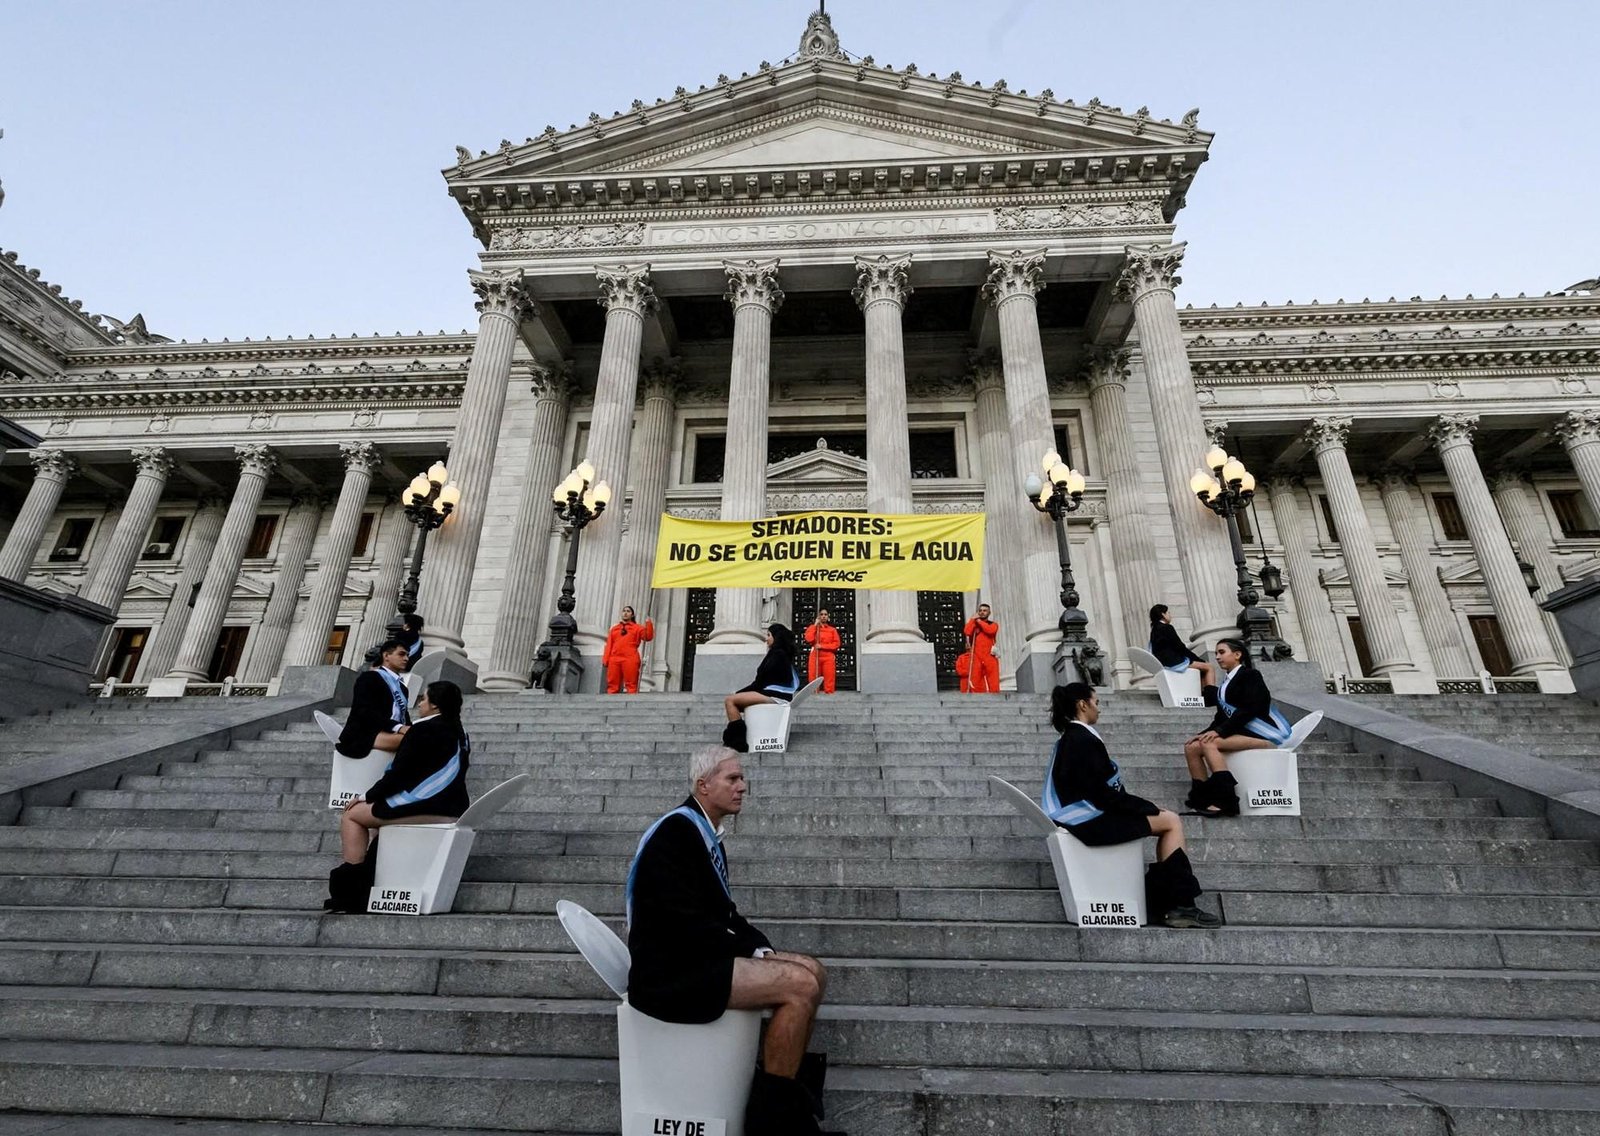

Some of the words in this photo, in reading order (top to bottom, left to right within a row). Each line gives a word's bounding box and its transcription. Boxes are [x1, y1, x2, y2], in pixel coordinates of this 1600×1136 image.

[671, 224, 817, 243] CONGRESO
[836, 218, 967, 236] NACIONAL
[751, 516, 893, 538] SENADORES:
[669, 543, 701, 561] NO
[708, 544, 736, 561] SE
[743, 540, 834, 561] CAGUEN
[841, 541, 871, 560] EN
[879, 542, 906, 561] EL
[911, 541, 974, 561] AGUA
[770, 569, 868, 583] GREENPEACE
[340, 791, 353, 800] LEY
[1257, 789, 1271, 797] LEY
[1273, 789, 1283, 797] DE
[1251, 798, 1293, 806] GLACIARES
[381, 889, 398, 900] LEY
[399, 890, 411, 901] DE
[371, 900, 418, 913] GLACIARES
[1090, 903, 1108, 913] LEY
[1111, 903, 1125, 913] DE
[1082, 915, 1137, 926] GLACIARES
[653, 1118, 681, 1136] LEY
[685, 1121, 705, 1136] DE
